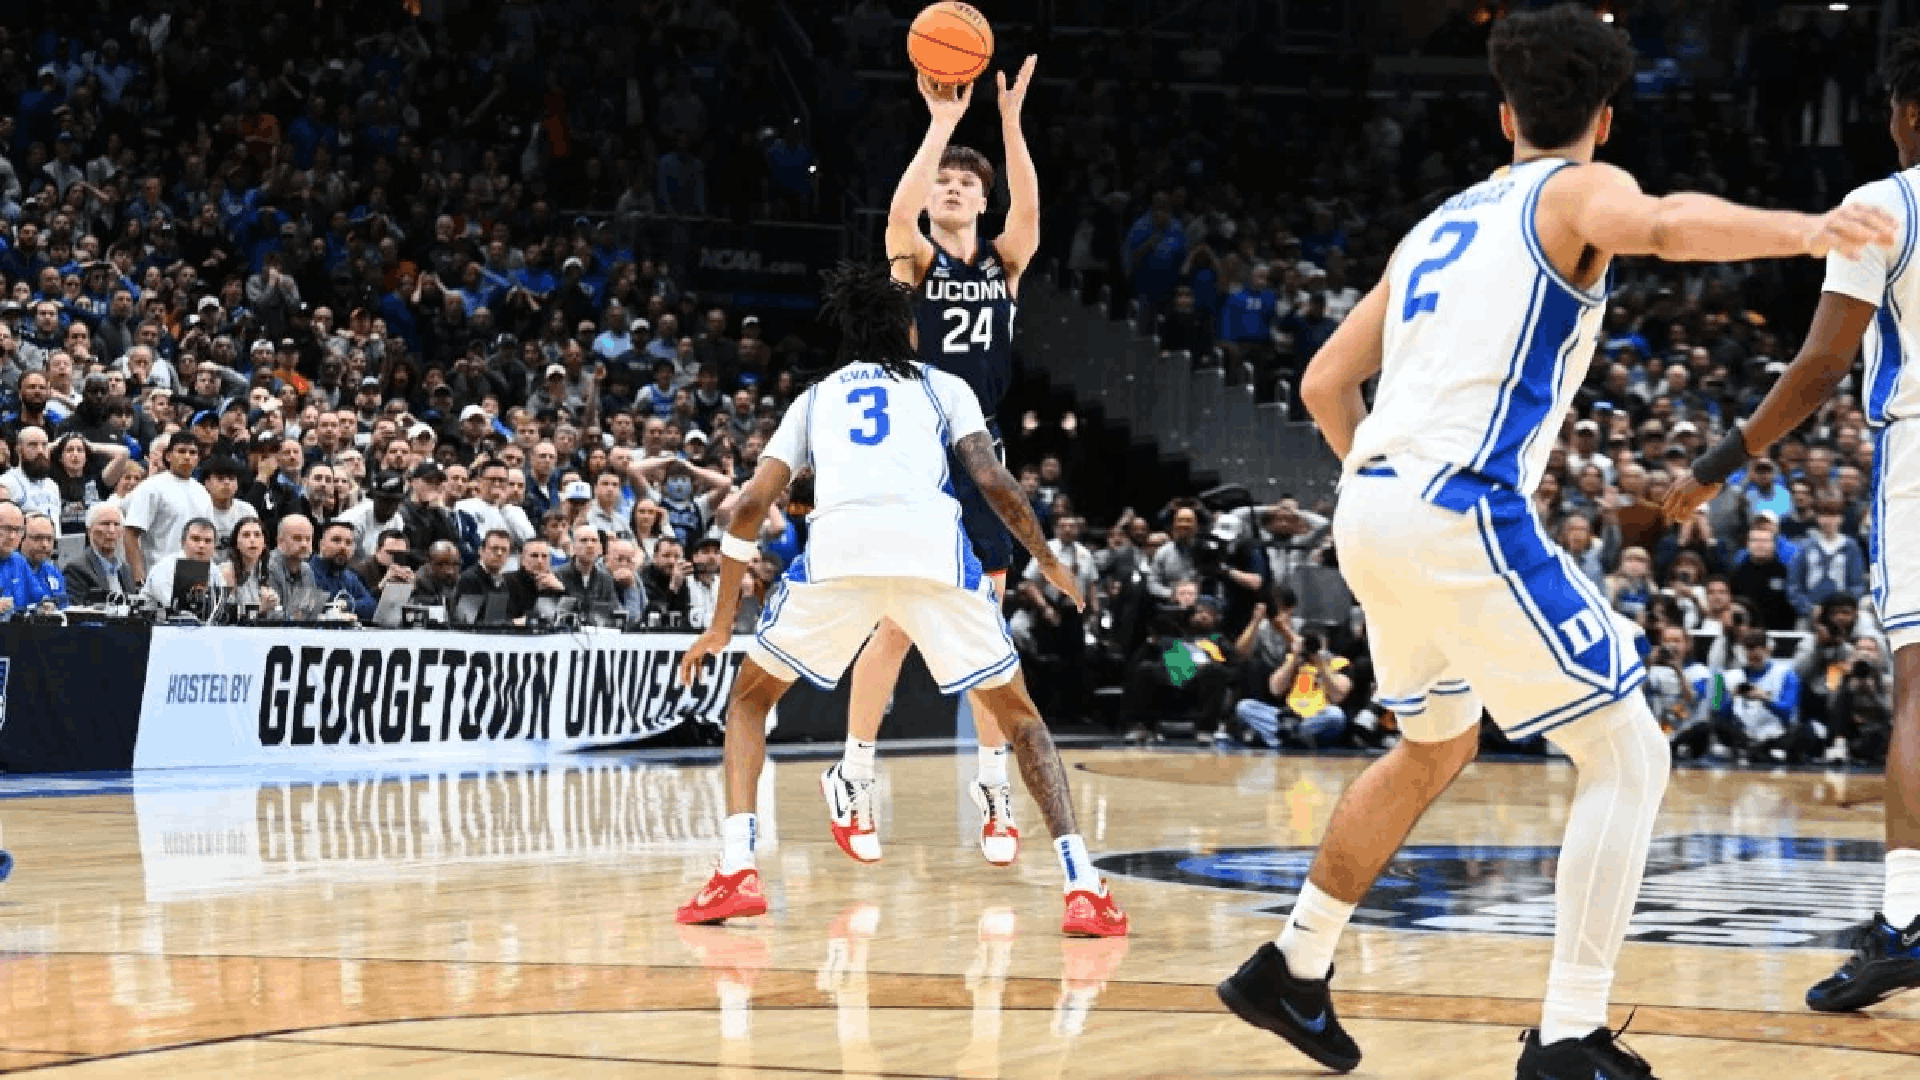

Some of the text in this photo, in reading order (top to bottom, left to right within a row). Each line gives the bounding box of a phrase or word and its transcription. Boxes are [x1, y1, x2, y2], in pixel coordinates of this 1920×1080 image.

[926, 279, 1007, 302] UCONN
[1402, 221, 1478, 322] 2
[942, 307, 994, 354] 24
[846, 386, 890, 446] 3
[166, 645, 749, 746] HOSTED BY GEORGETOWN UNIVERSIT
